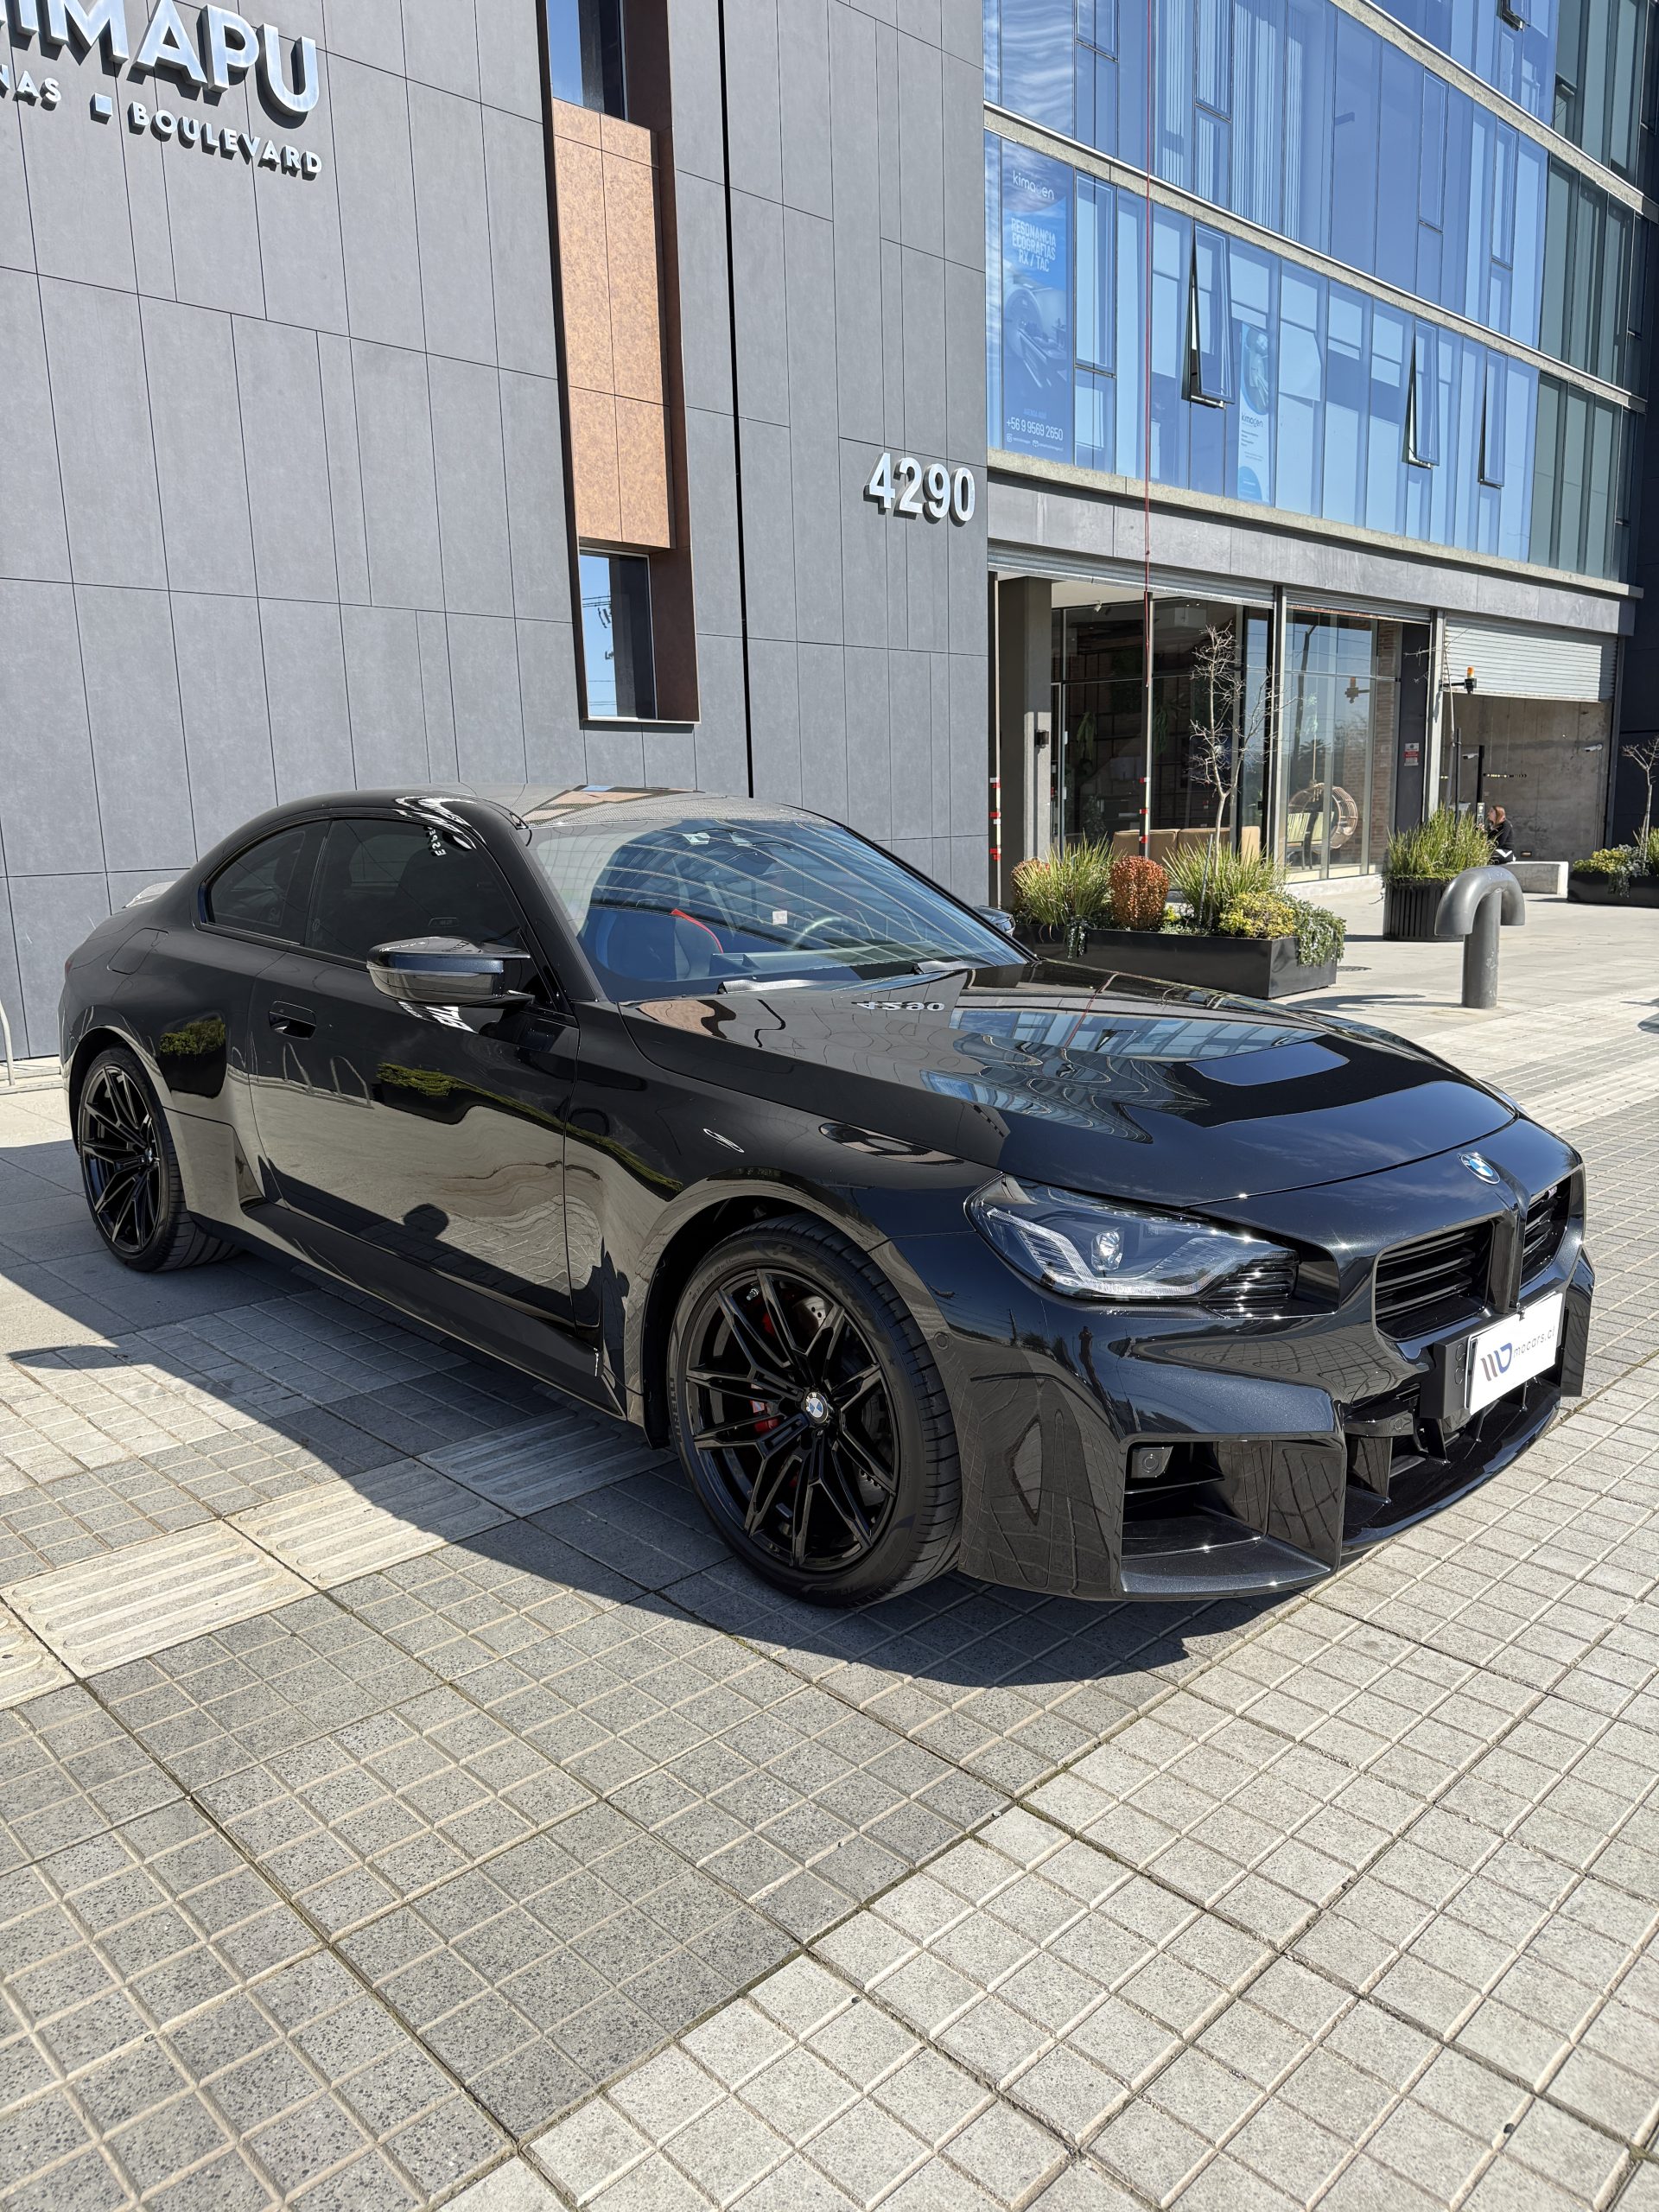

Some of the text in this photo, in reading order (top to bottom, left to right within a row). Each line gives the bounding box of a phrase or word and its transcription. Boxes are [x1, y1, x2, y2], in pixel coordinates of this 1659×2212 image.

[0, 0, 320, 112] MAPU
[130, 100, 322, 175] BOULEVARD
[1011, 217, 1057, 247] RESONANCIA
[1019, 248, 1029, 266] RX
[1035, 255, 1050, 273] TAC
[1006, 416, 1020, 431] +56
[1020, 419, 1027, 432] 9
[1027, 421, 1045, 436] 9569
[1046, 424, 1064, 442] 2650
[867, 452, 976, 522] 4290
